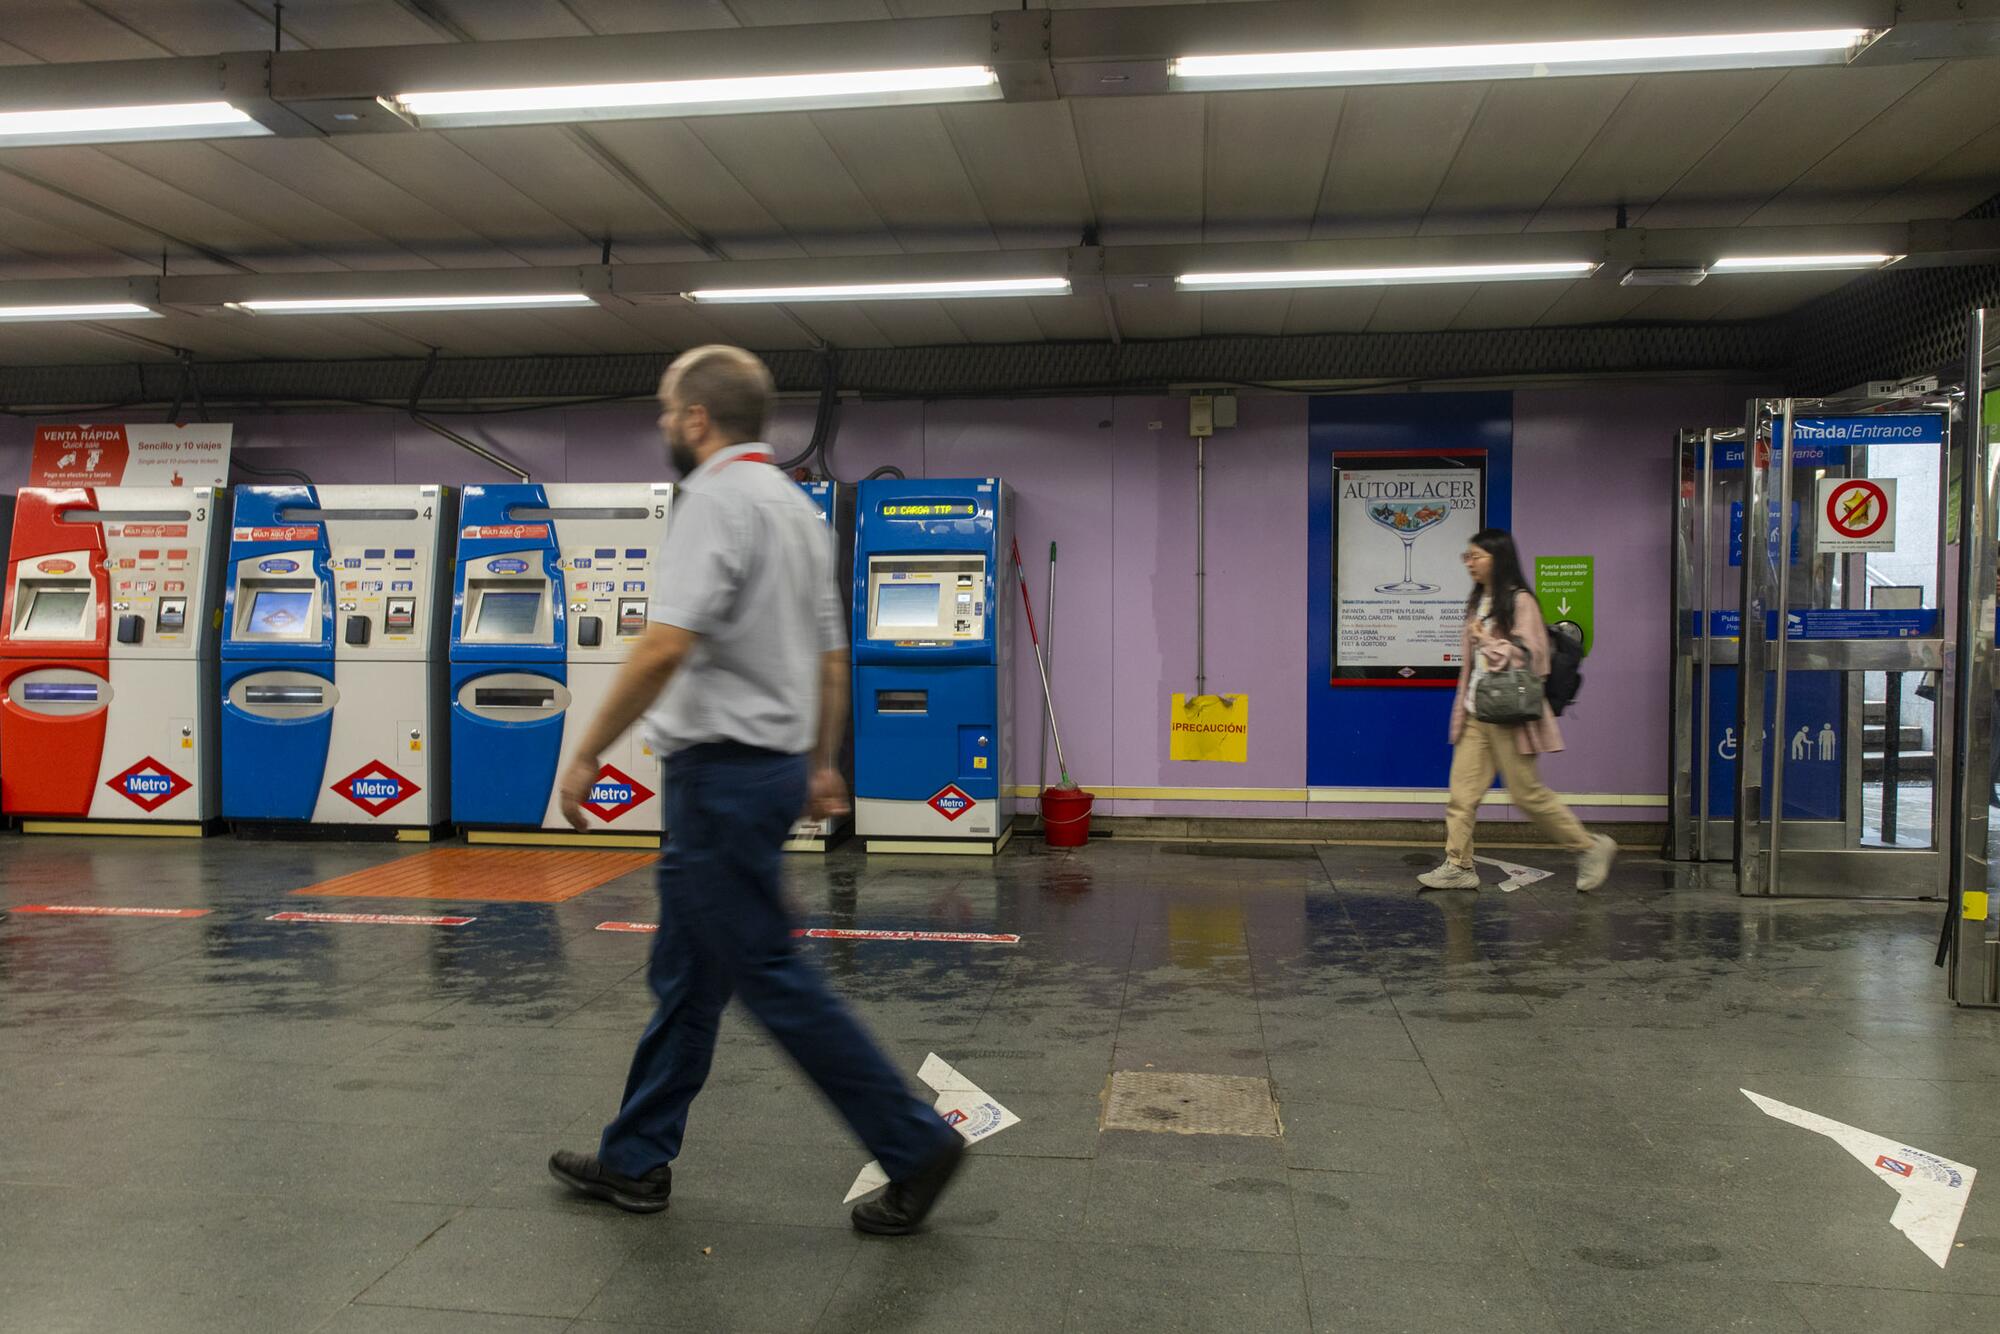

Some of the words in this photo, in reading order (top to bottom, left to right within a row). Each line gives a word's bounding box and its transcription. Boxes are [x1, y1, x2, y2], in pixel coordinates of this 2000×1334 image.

[44, 431, 77, 441] VENTA
[81, 428, 121, 441] RÁPIDA
[1792, 423, 1922, 440] ntrada/Entrance
[62, 441, 82, 449] Quick
[138, 441, 173, 450] Sencillo
[175, 443, 181, 451] y
[183, 441, 194, 450] 10
[196, 441, 222, 452] viajes
[1344, 481, 1476, 498] AUTOPLACER
[883, 506, 897, 515] LO
[900, 505, 930, 515] CARGA
[934, 505, 953, 514] TTP
[1450, 498, 1476, 510] 2023
[196, 508, 206, 521] 3
[422, 506, 433, 520] 4
[654, 505, 664, 519] 5
[1172, 722, 1246, 734] ¡PRECAUCIÓN!
[130, 777, 168, 792] Metro
[356, 781, 396, 796] Metro
[589, 786, 629, 800] Metro
[940, 799, 964, 808] Metro
[629, 921, 659, 929] MAN
